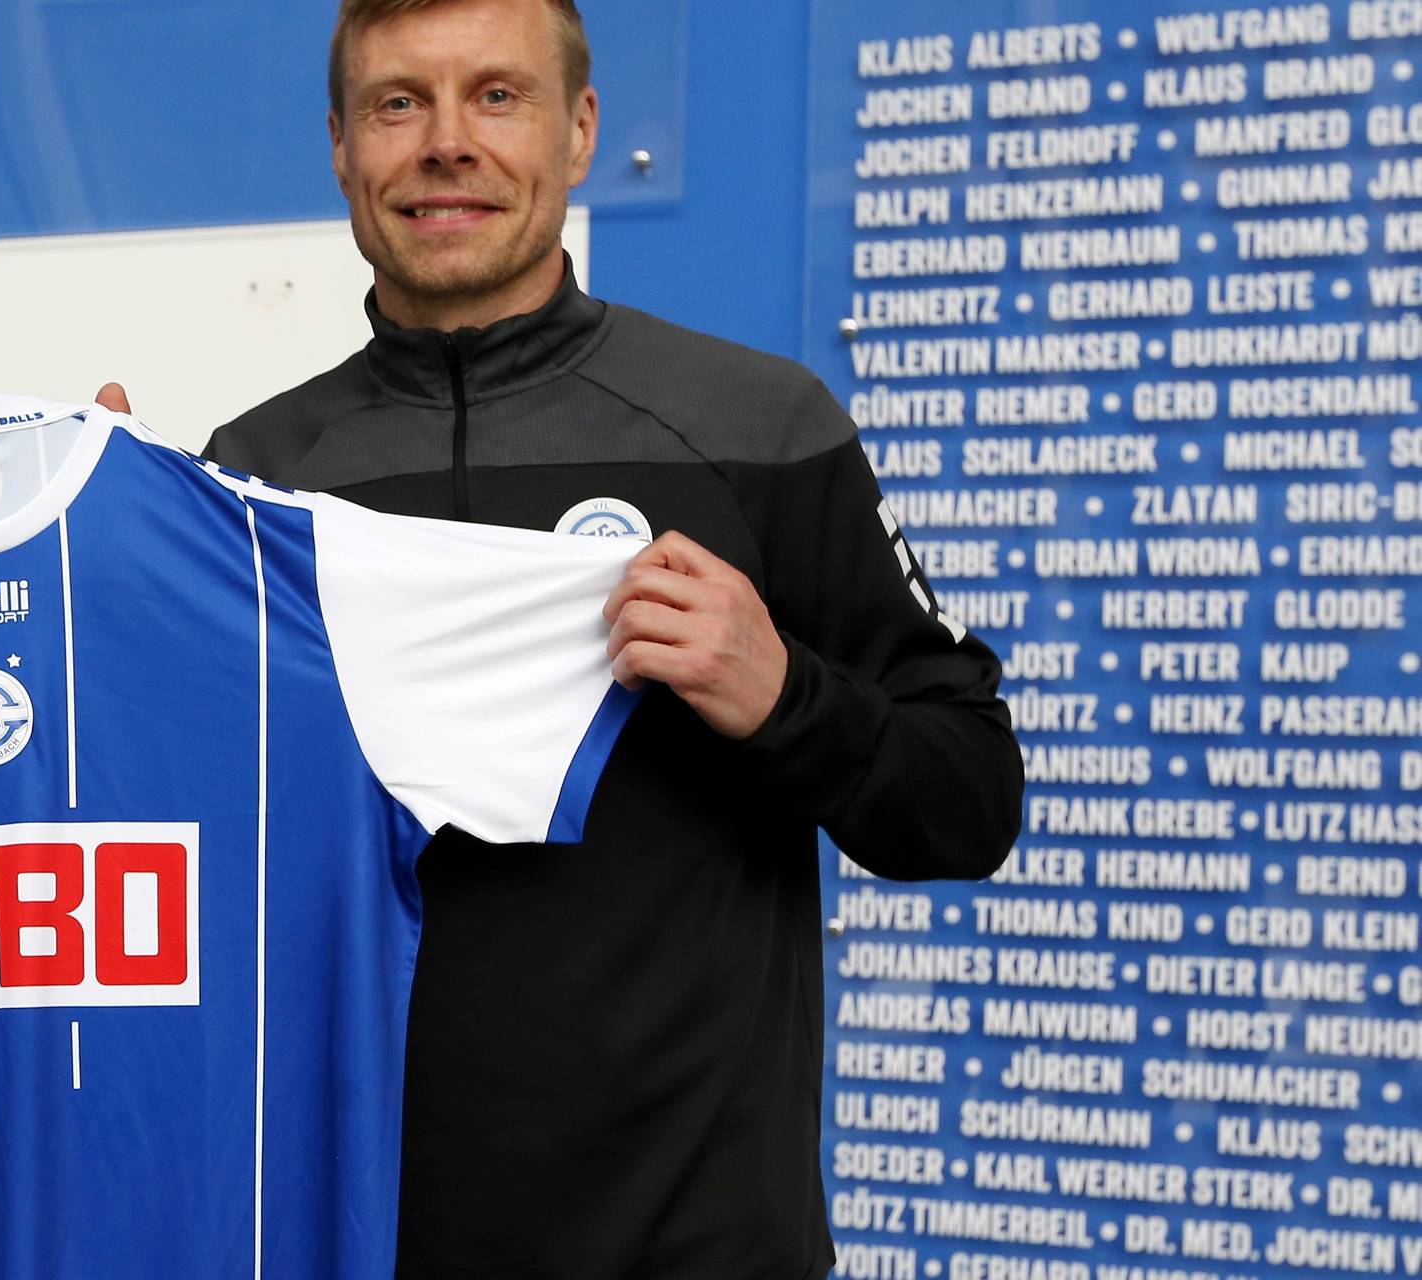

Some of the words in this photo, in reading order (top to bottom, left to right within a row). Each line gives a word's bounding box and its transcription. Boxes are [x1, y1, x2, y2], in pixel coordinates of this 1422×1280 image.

[859, 34, 953, 76] KLAUS
[967, 23, 1101, 68] ALBERTS
[1155, 3, 1330, 53] WOLFGANG
[857, 85, 973, 127] JOCHEN
[988, 75, 1091, 118] BRAND
[1144, 63, 1247, 106] KLAUS
[1263, 54, 1375, 99] BRAND
[855, 135, 971, 178] JOCHEN
[987, 123, 1138, 169] FELDHOFF
[1195, 109, 1351, 155] MANFRED
[855, 187, 950, 227] RALPH
[965, 175, 1163, 221] HEINZEMANN
[1216, 162, 1352, 208] GUNNAR
[854, 235, 1007, 278] EBERHARD
[1020, 226, 1181, 269] KIENBAUM
[1235, 215, 1369, 259] THOMAS
[851, 286, 1000, 331] LEHNERTZ
[1048, 277, 1193, 321] GERHARD
[1207, 271, 1313, 313] LEISTE
[851, 338, 991, 377] VALENTIN
[995, 331, 1141, 372] MARKSER
[1171, 322, 1363, 367] BURKHARDT
[849, 386, 965, 428] GÜNTER
[976, 385, 1090, 424] RIEMER
[1133, 381, 1218, 420] GERD
[1229, 375, 1417, 417] ROSENDAHL
[962, 435, 1157, 476] SCHLAGHECK
[1224, 430, 1365, 469] MICHAEL
[1132, 485, 1258, 524] ZLATAN
[1034, 539, 1138, 577] URBAN
[1146, 537, 1261, 576] WRONA
[1102, 590, 1248, 628] HERBERT
[1275, 589, 1404, 629] GLODDE
[1001, 642, 1079, 679] JOST
[1140, 643, 1240, 680] PETER
[1261, 643, 1349, 681] KAUP
[1150, 695, 1244, 733] HEINZ
[1206, 748, 1381, 789] WOLFGANG
[1029, 796, 1129, 835] FRANK
[1133, 799, 1233, 838] GREBE
[1265, 803, 1345, 841] LUTZ
[1096, 851, 1251, 890] HERMANN
[1297, 856, 1406, 897] BERND
[836, 887, 932, 932] HÖVER
[974, 897, 1097, 938] THOMAS
[1108, 903, 1183, 941] KIND
[1226, 906, 1312, 947] GERD
[1323, 910, 1418, 950] KLEIN
[838, 942, 992, 983] JOHANNES
[997, 949, 1114, 989] KRAUSE
[1147, 955, 1256, 995] DIETER
[1261, 959, 1366, 1002] LANGE
[837, 992, 970, 1033] ANDREAS
[983, 1000, 1137, 1042] MAIWURM
[1187, 1010, 1292, 1052] HORST
[836, 1041, 946, 1082] RIEMER
[1001, 1046, 1123, 1093] JÜRGEN
[1143, 1059, 1360, 1108] SCHUMACHER
[835, 1093, 940, 1133] ULRICH
[960, 1097, 1151, 1147] SCHÜRMANN
[1218, 1118, 1321, 1160] KLAUS
[834, 1142, 944, 1183] SOEDER
[975, 1152, 1050, 1193] KARL
[1057, 1159, 1187, 1202] WERNER
[1193, 1167, 1293, 1211] STERK
[1327, 1177, 1380, 1217] DR.
[832, 1190, 906, 1232] GÖTZ
[911, 1198, 1091, 1248] TIMMERBEIL
[1125, 1215, 1174, 1254] DR.
[1182, 1219, 1258, 1260] MED.
[1265, 1227, 1395, 1271] JOCHEN
